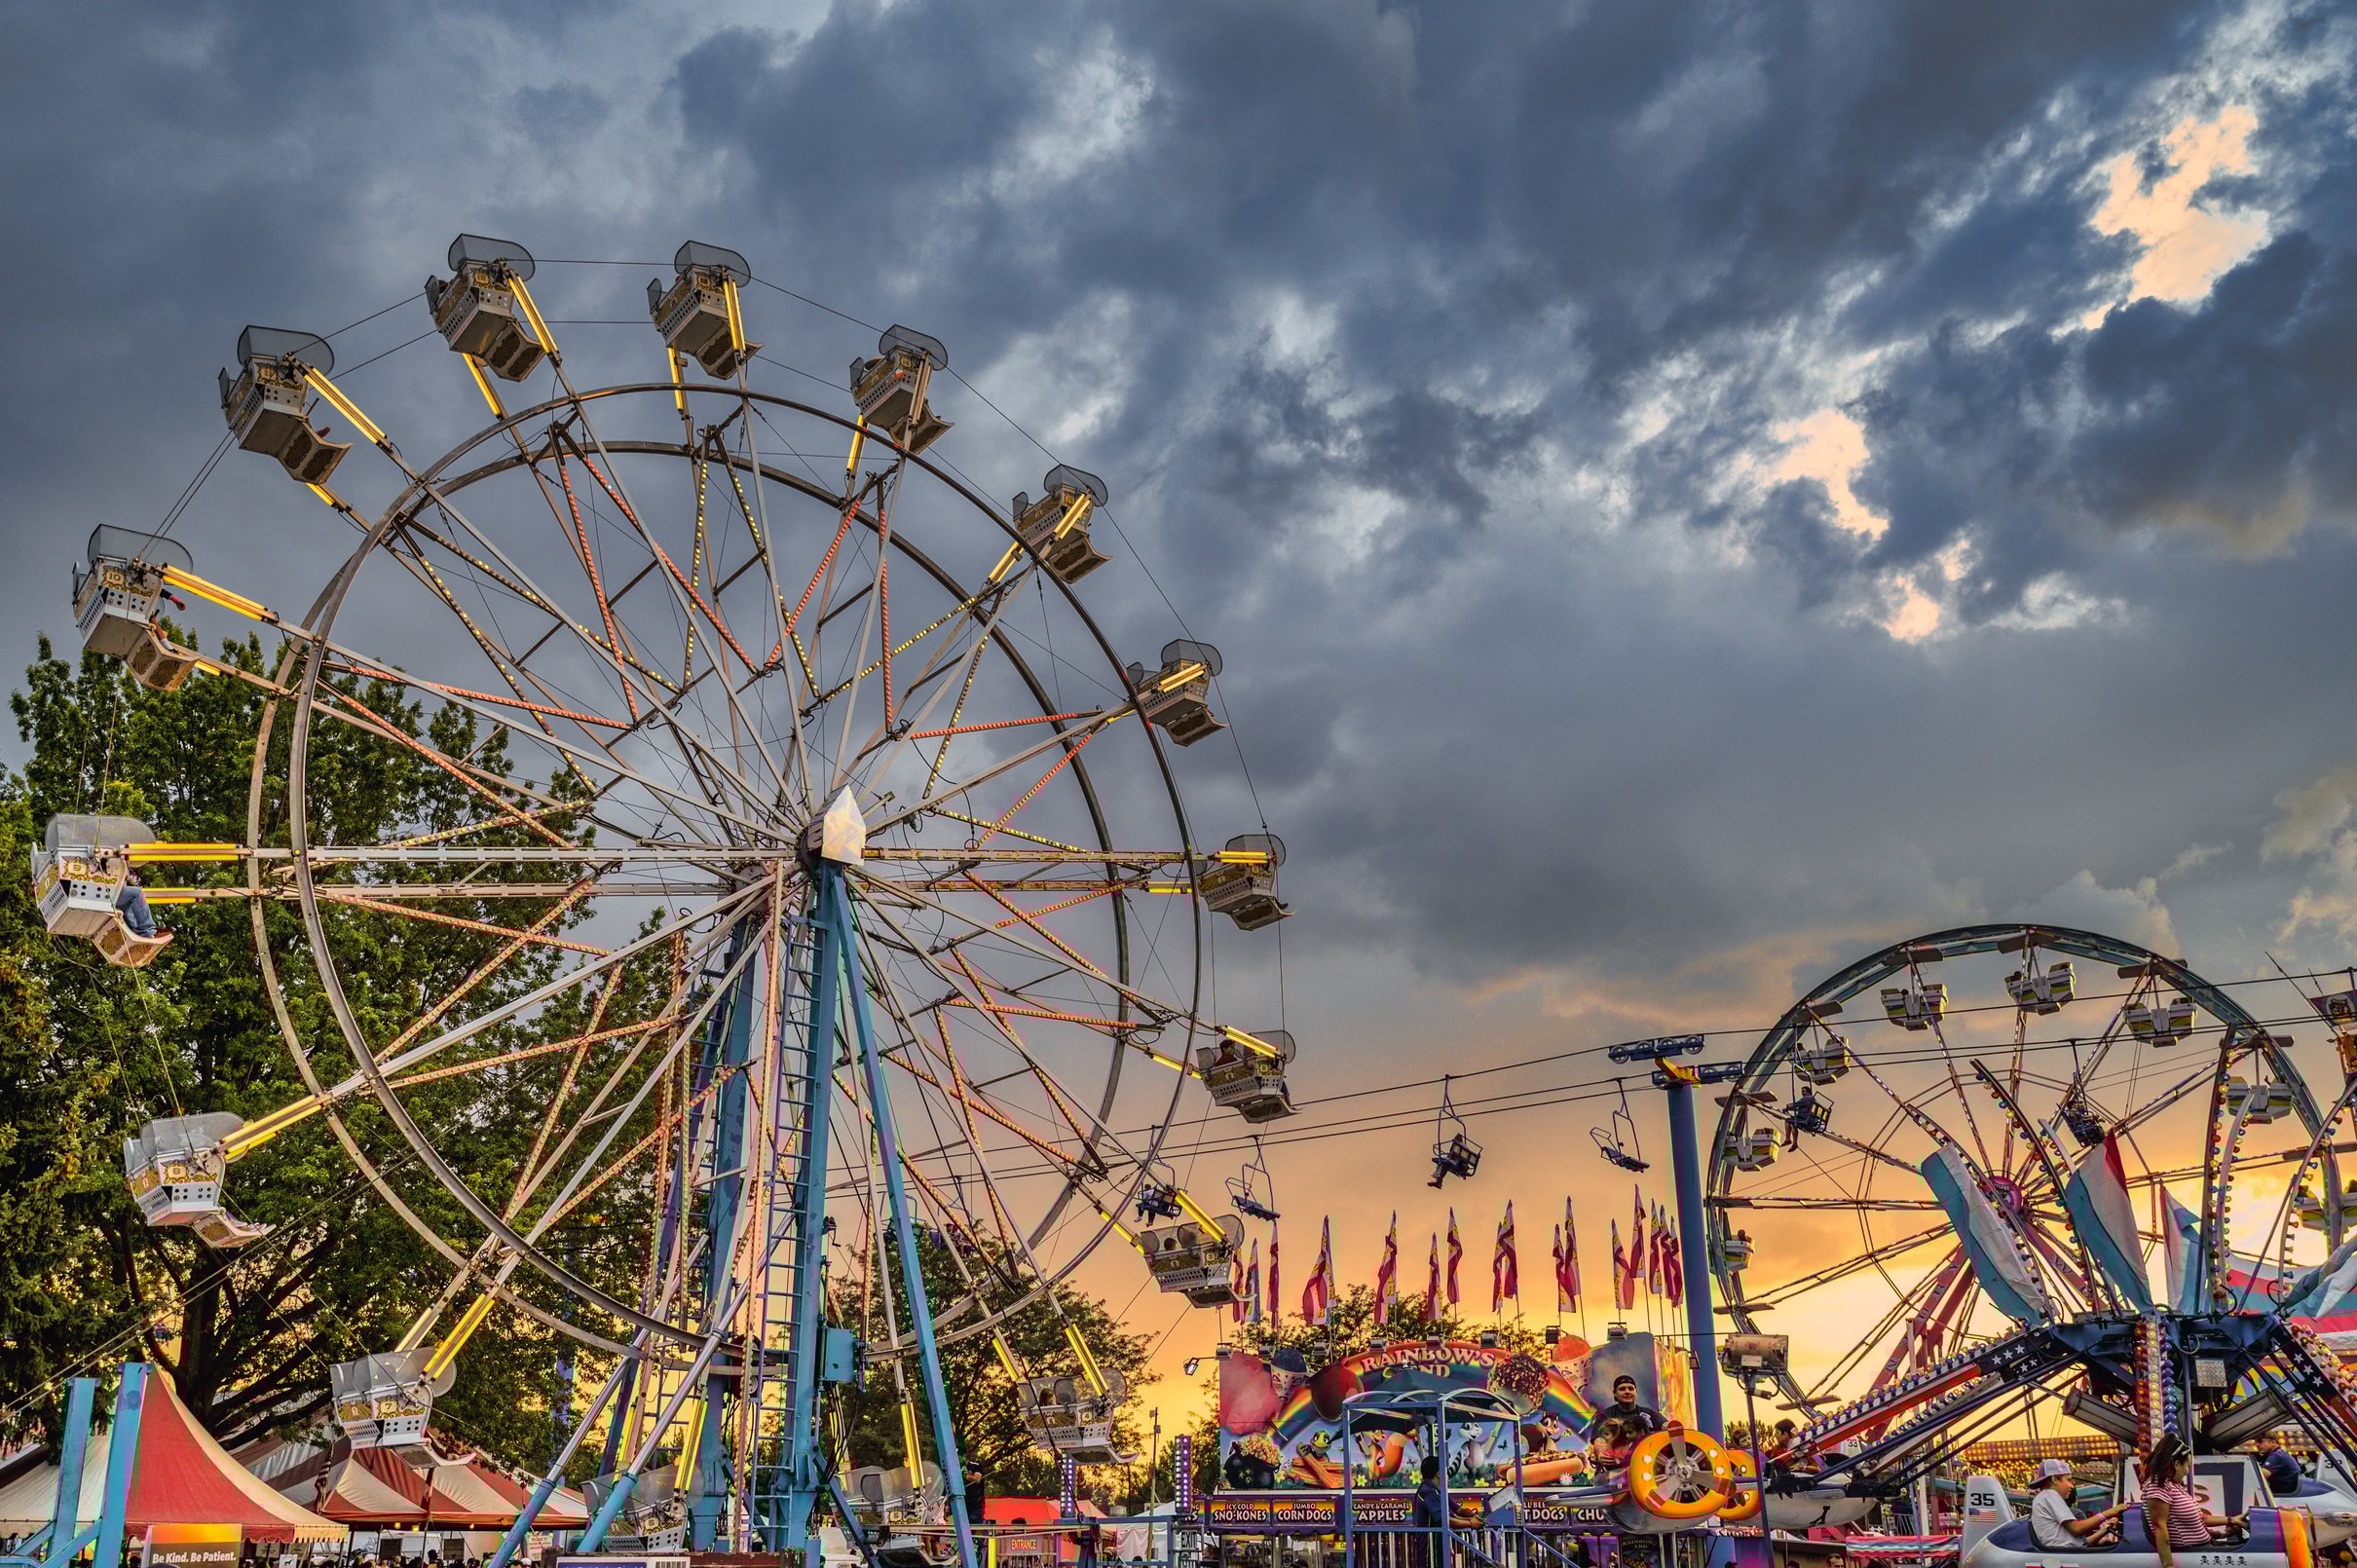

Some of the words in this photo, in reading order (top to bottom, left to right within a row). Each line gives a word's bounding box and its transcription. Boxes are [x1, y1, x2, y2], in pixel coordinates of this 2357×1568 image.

[109, 573, 121, 581] 10
[1362, 1347, 1495, 1372] RAINBOW'S
[1848, 1438, 1858, 1448] 33
[1970, 1493, 1995, 1507] 35
[1215, 1510, 1267, 1521] SNO-KONES
[1278, 1510, 1306, 1521] CORN
[1307, 1510, 1332, 1521] DOGS
[1358, 1510, 1406, 1521] APPLES
[1533, 1509, 1565, 1521] DOGS
[1011, 1539, 1036, 1550] ENTRANCE
[1181, 1531, 1197, 1549] EXIT
[152, 1553, 164, 1564] Be
[166, 1552, 189, 1564] Kind.
[190, 1551, 203, 1563] Be
[203, 1550, 237, 1562] Patient.
